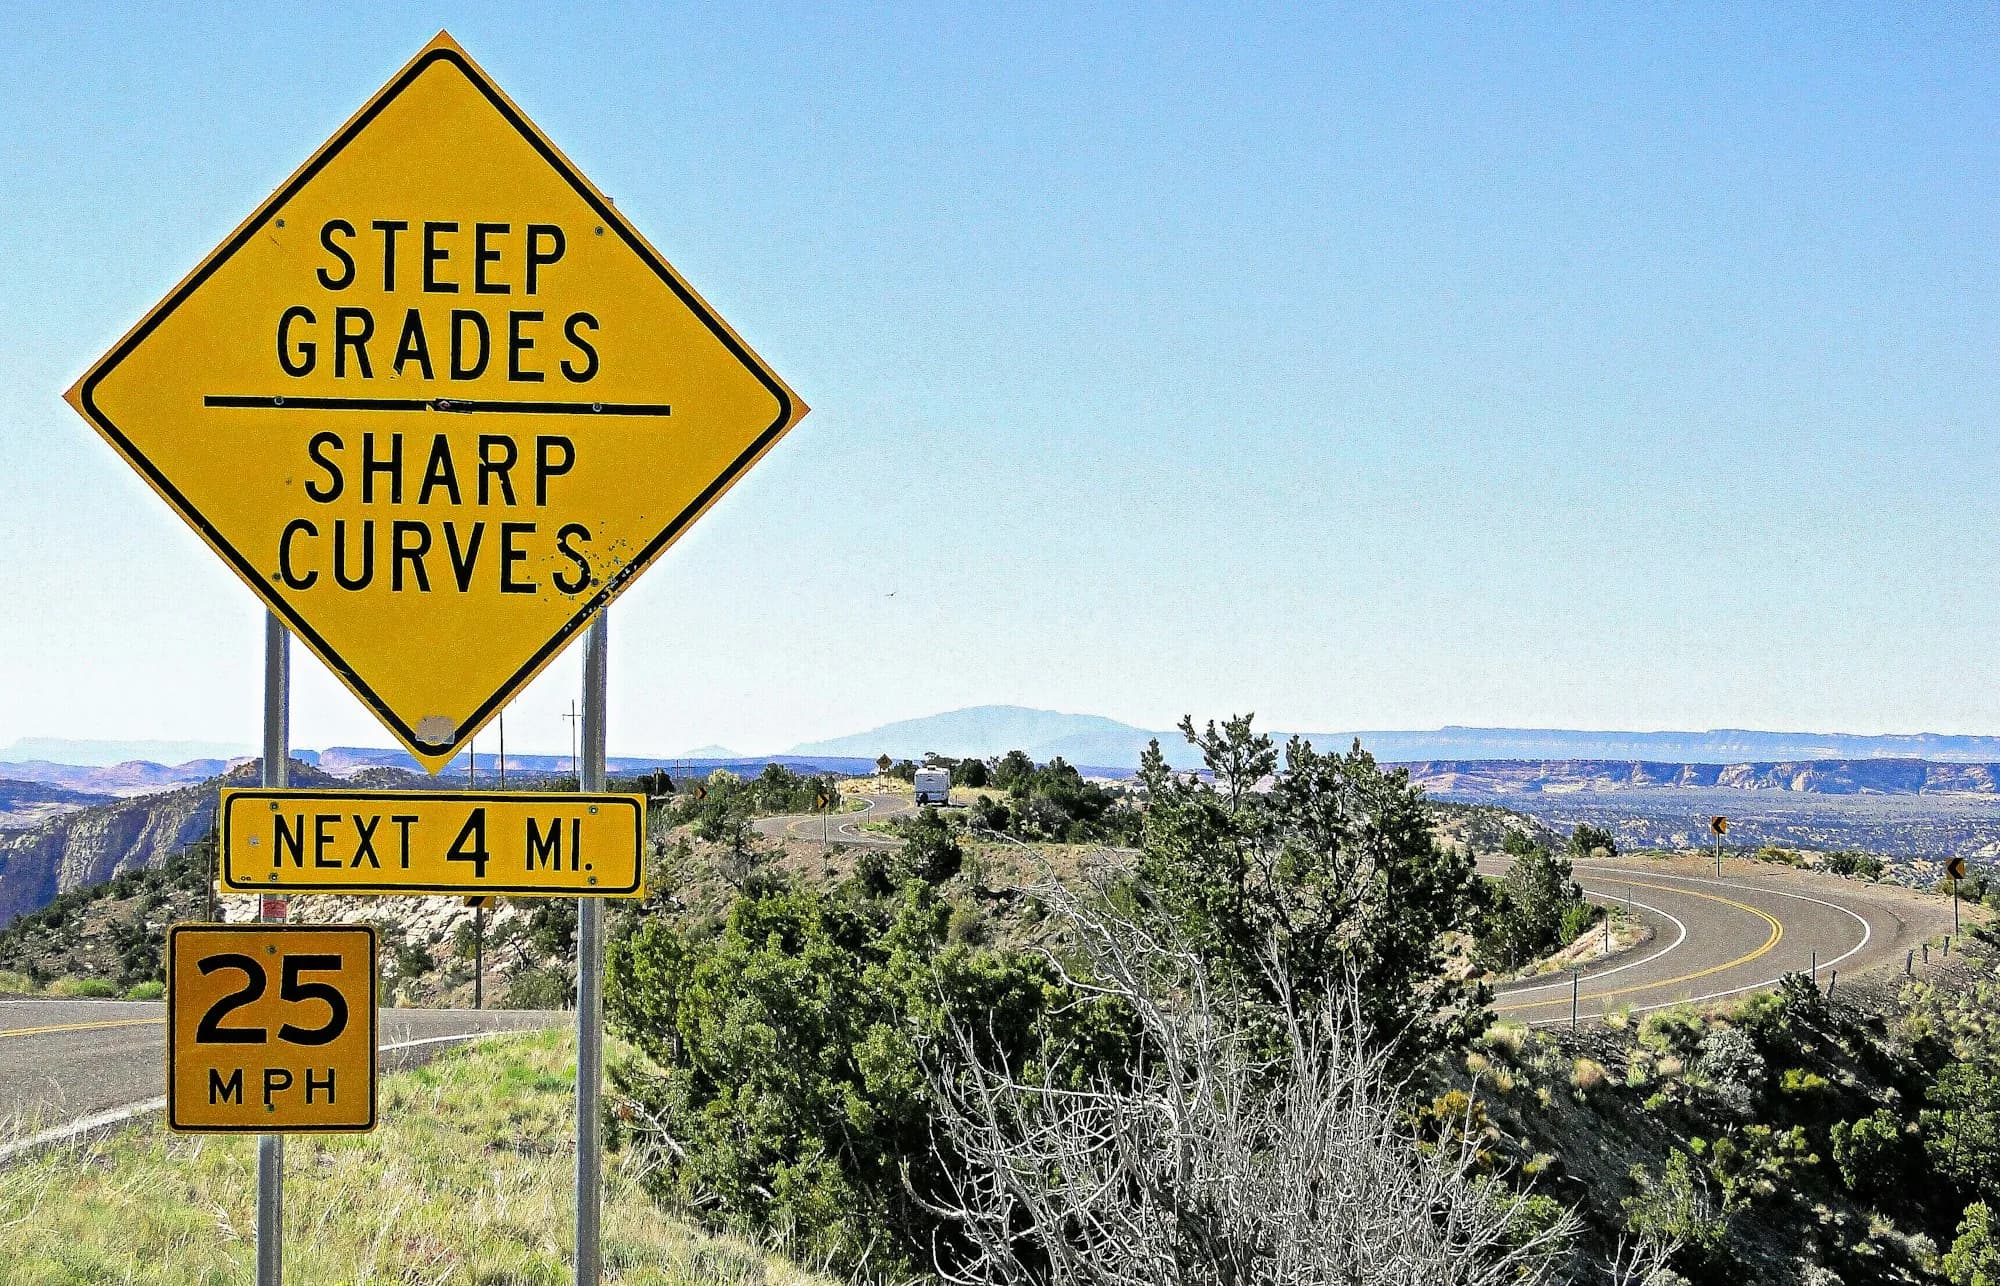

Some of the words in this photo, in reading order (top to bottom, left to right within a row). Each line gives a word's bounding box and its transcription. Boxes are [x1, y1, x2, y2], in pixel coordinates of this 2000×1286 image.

[316, 219, 566, 295] STEEP
[277, 305, 600, 383] GRADES
[304, 431, 576, 507] SHARP
[279, 518, 594, 595] CURVES
[273, 814, 419, 869] NEXT
[446, 807, 490, 879] 4
[526, 817, 594, 872] MI.
[195, 953, 349, 1046] 25
[208, 1067, 336, 1106] MPH
